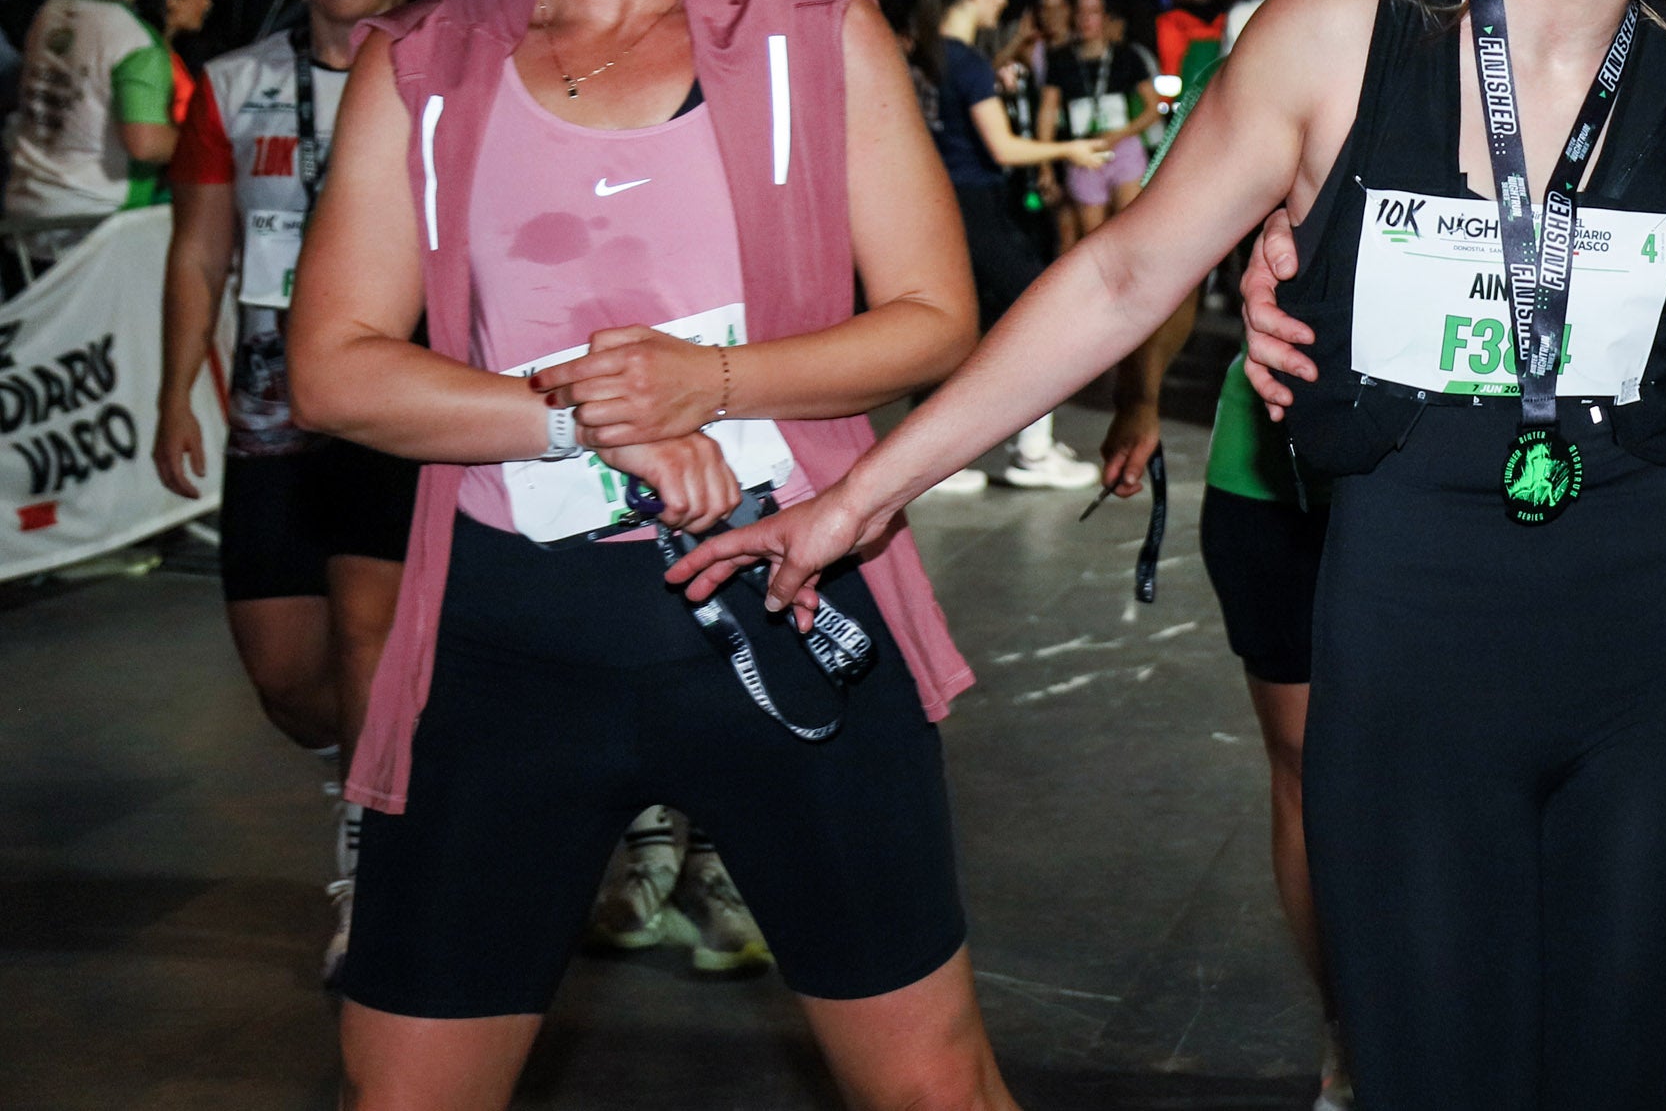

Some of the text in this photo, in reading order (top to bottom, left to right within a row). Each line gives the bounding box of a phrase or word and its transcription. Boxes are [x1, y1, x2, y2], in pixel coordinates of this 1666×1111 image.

[1598, 0, 1641, 93] FINISHER
[1478, 37, 1517, 135] FINISHER
[1375, 198, 1426, 238] 10K
[1539, 190, 1572, 291] FINISHER
[1641, 234, 1658, 263] 4
[1480, 384, 1503, 393] JUN
